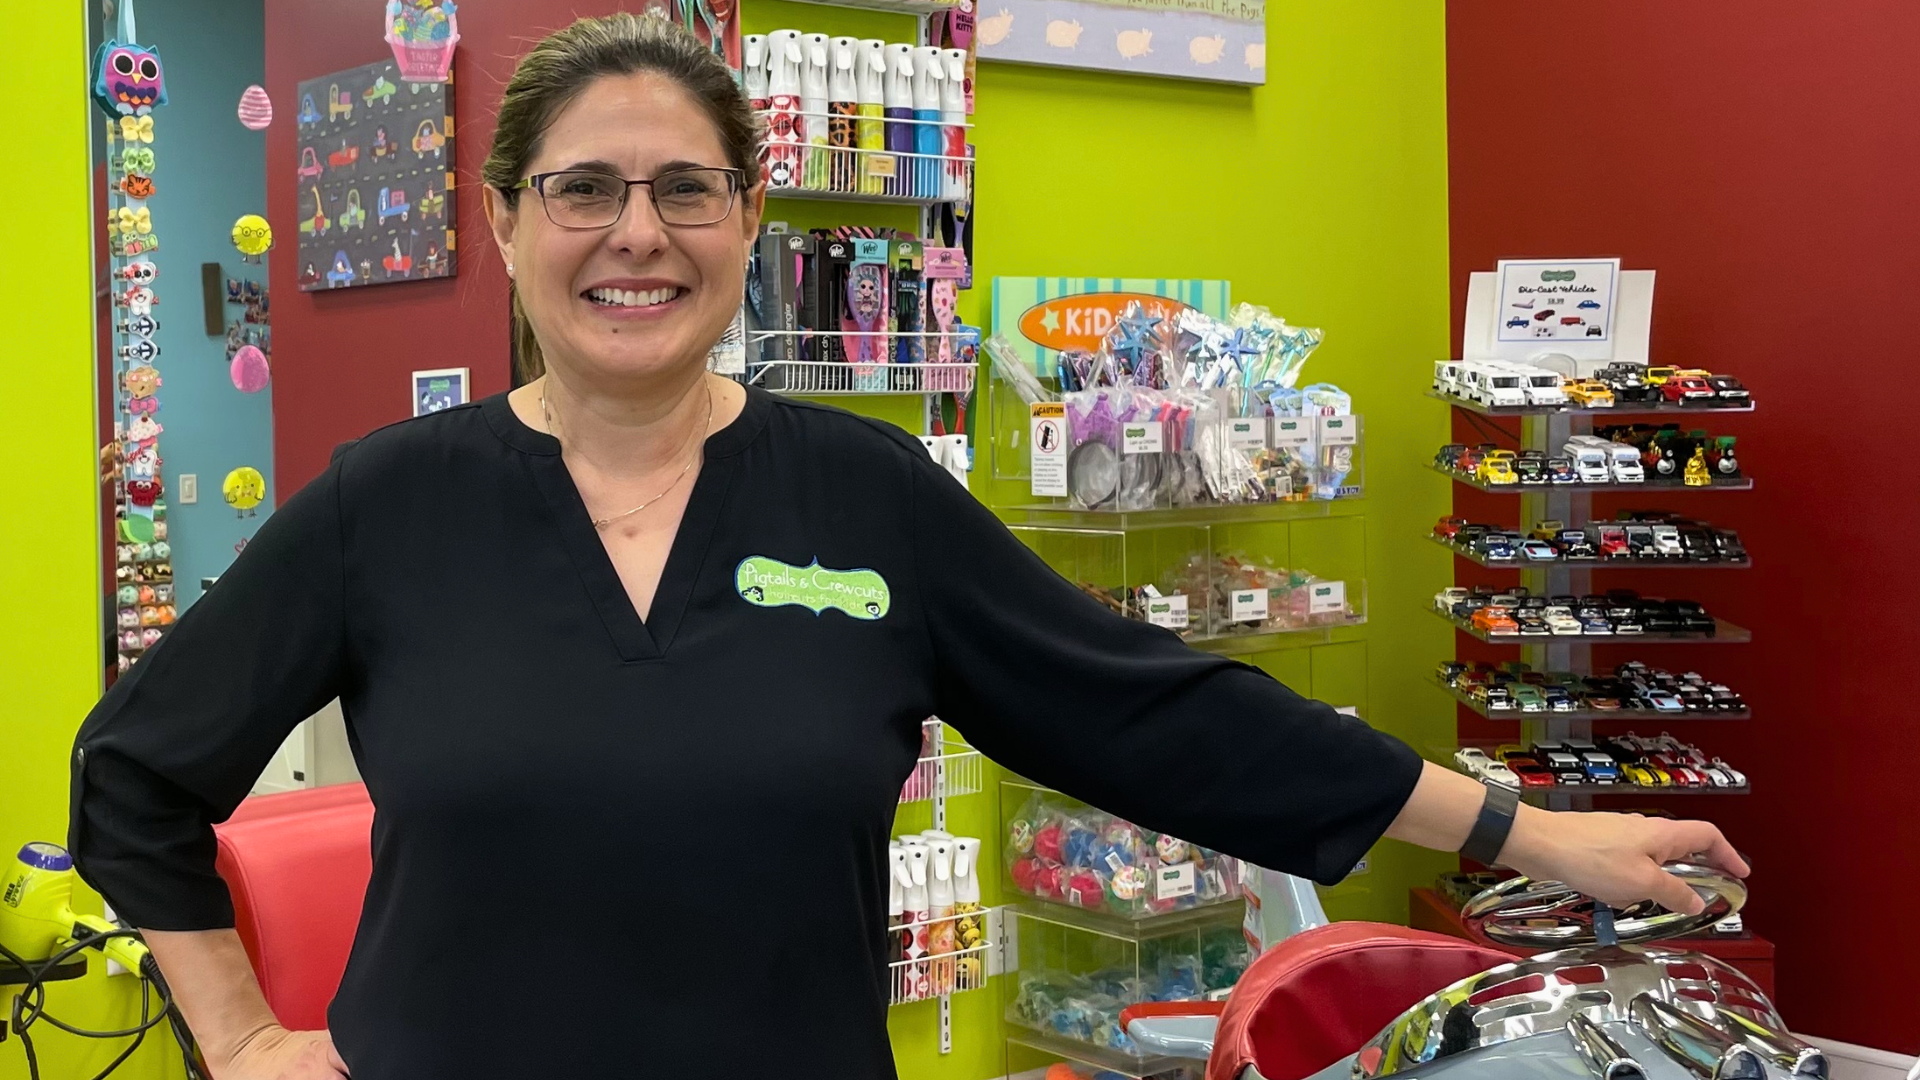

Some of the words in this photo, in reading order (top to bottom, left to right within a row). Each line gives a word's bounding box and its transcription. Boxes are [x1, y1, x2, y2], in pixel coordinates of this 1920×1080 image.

[1221, 0, 1235, 15] the
[956, 14, 974, 24] HELLO
[956, 23, 973, 32] KITTY
[1518, 286, 1558, 294] Die-Cast
[1559, 284, 1597, 293] Vehicles
[784, 302, 794, 346] deangler
[1039, 406, 1064, 414] CAUTION
[745, 562, 796, 588] Pigtails
[800, 577, 809, 589] &
[812, 569, 884, 600] Crewcuts
